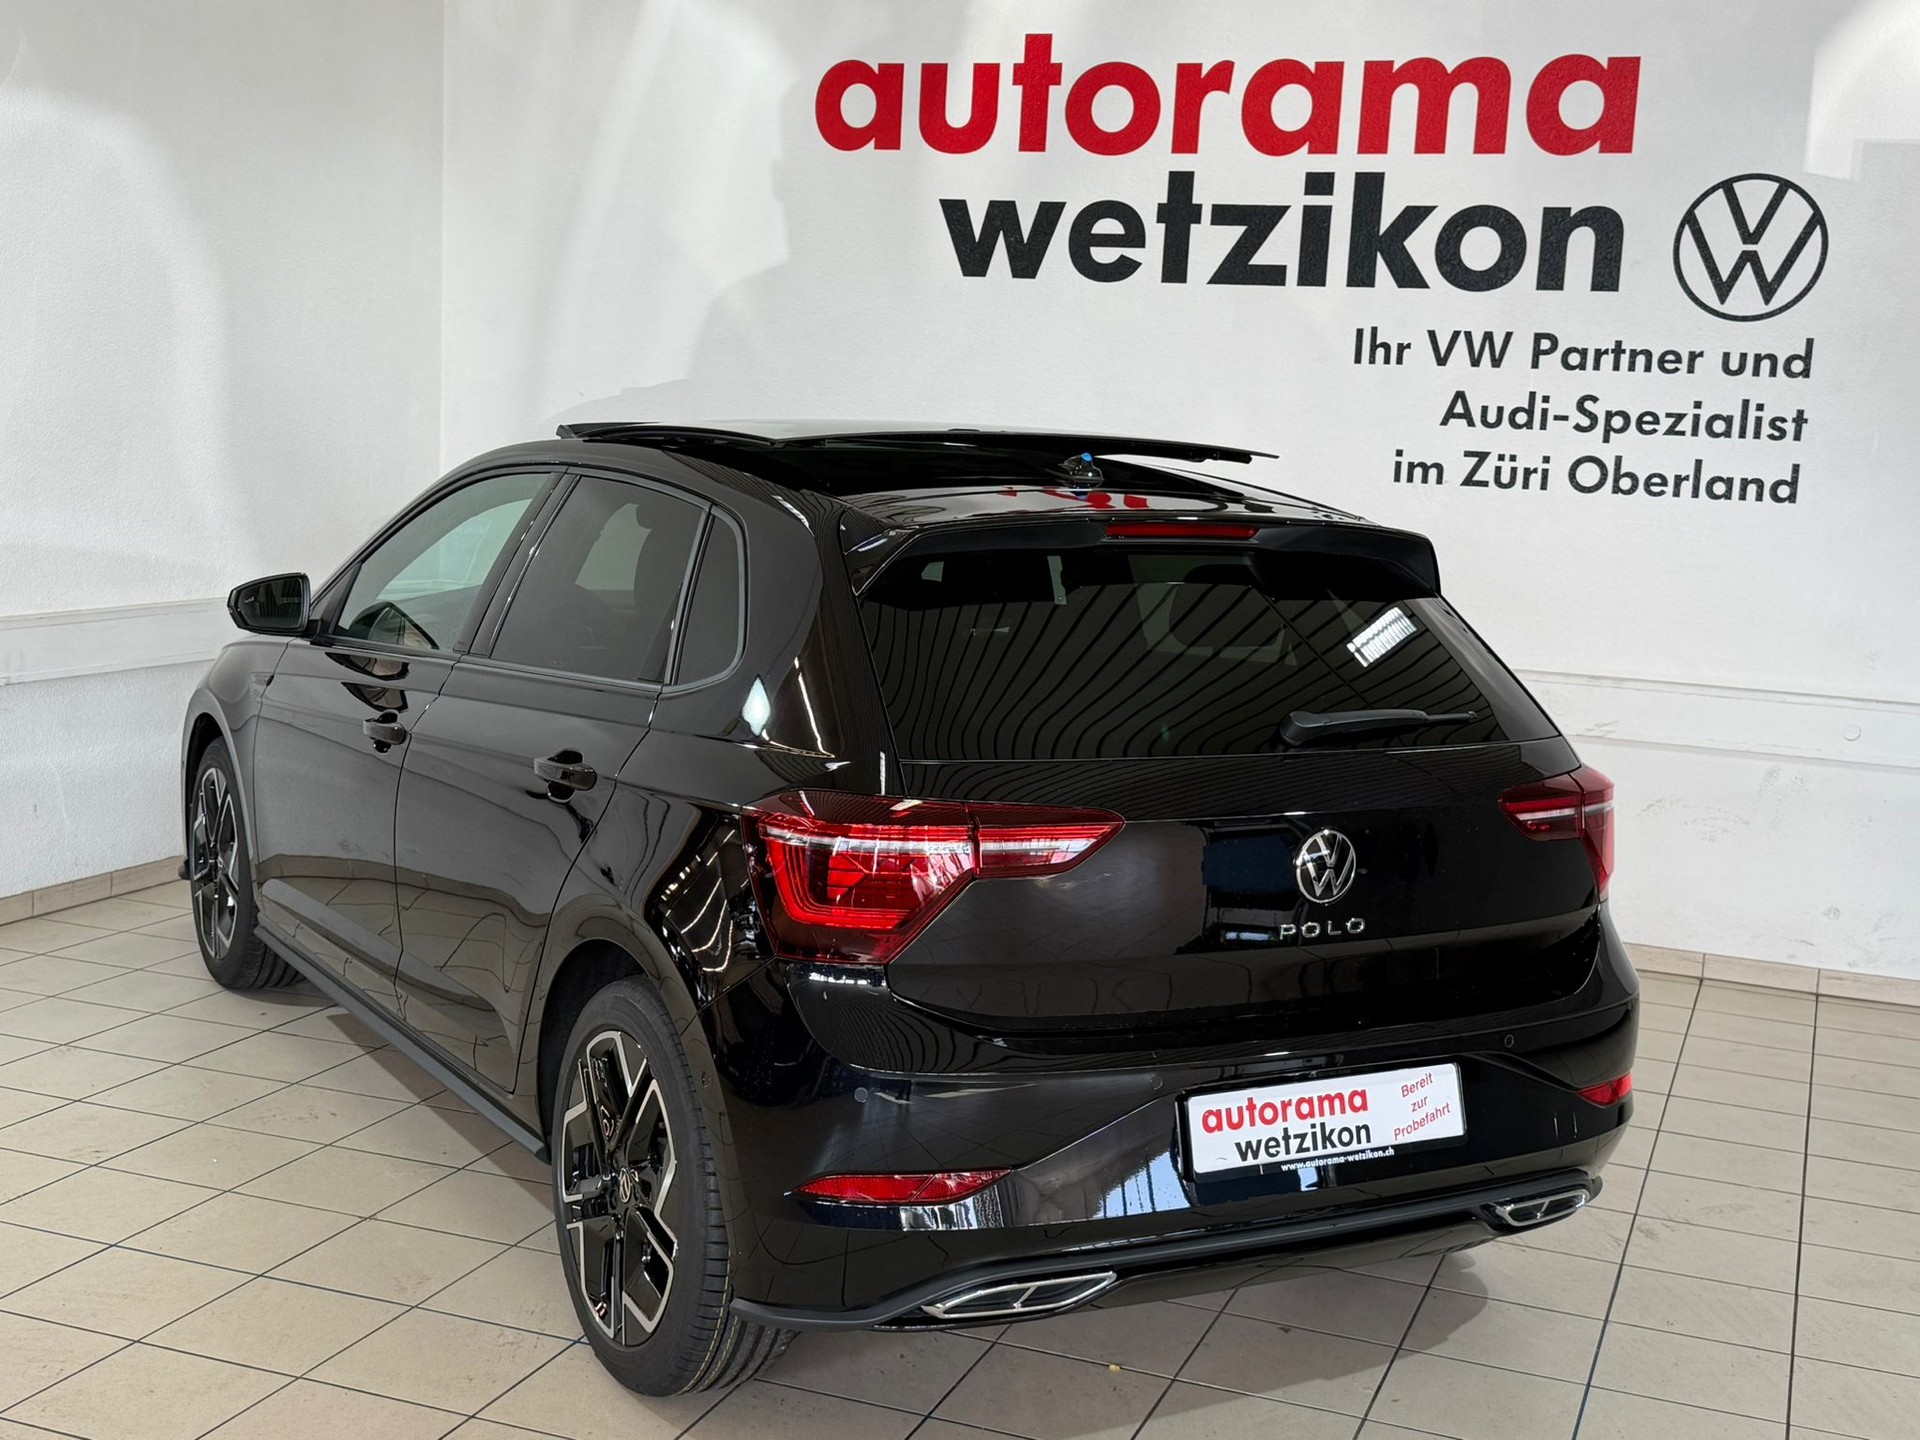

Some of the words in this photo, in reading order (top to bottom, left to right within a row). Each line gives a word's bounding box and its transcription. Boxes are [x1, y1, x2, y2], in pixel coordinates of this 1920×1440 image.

[816, 34, 1640, 156] autorama
[939, 171, 1624, 292] wetzikon
[1674, 174, 1828, 322] VW
[1354, 326, 1411, 365] Ihr
[1427, 330, 1513, 368] VW
[1531, 333, 1704, 374] Partner
[1721, 338, 1814, 378] und
[1440, 391, 1808, 443] Audi-Spezialist
[1393, 449, 1444, 484] im
[1460, 450, 1550, 490] Züri
[1568, 455, 1800, 503] Oberland
[1296, 830, 1356, 904] VW
[1279, 917, 1365, 940] POLO
[1401, 1072, 1433, 1098] Bereit
[1411, 1094, 1429, 1113] zur
[1202, 1088, 1369, 1134] autorama
[1393, 1102, 1451, 1141] Probefahrt
[1234, 1122, 1372, 1162] wetzikon
[1281, 1146, 1395, 1172] www.autorama-wetzikon.ch
